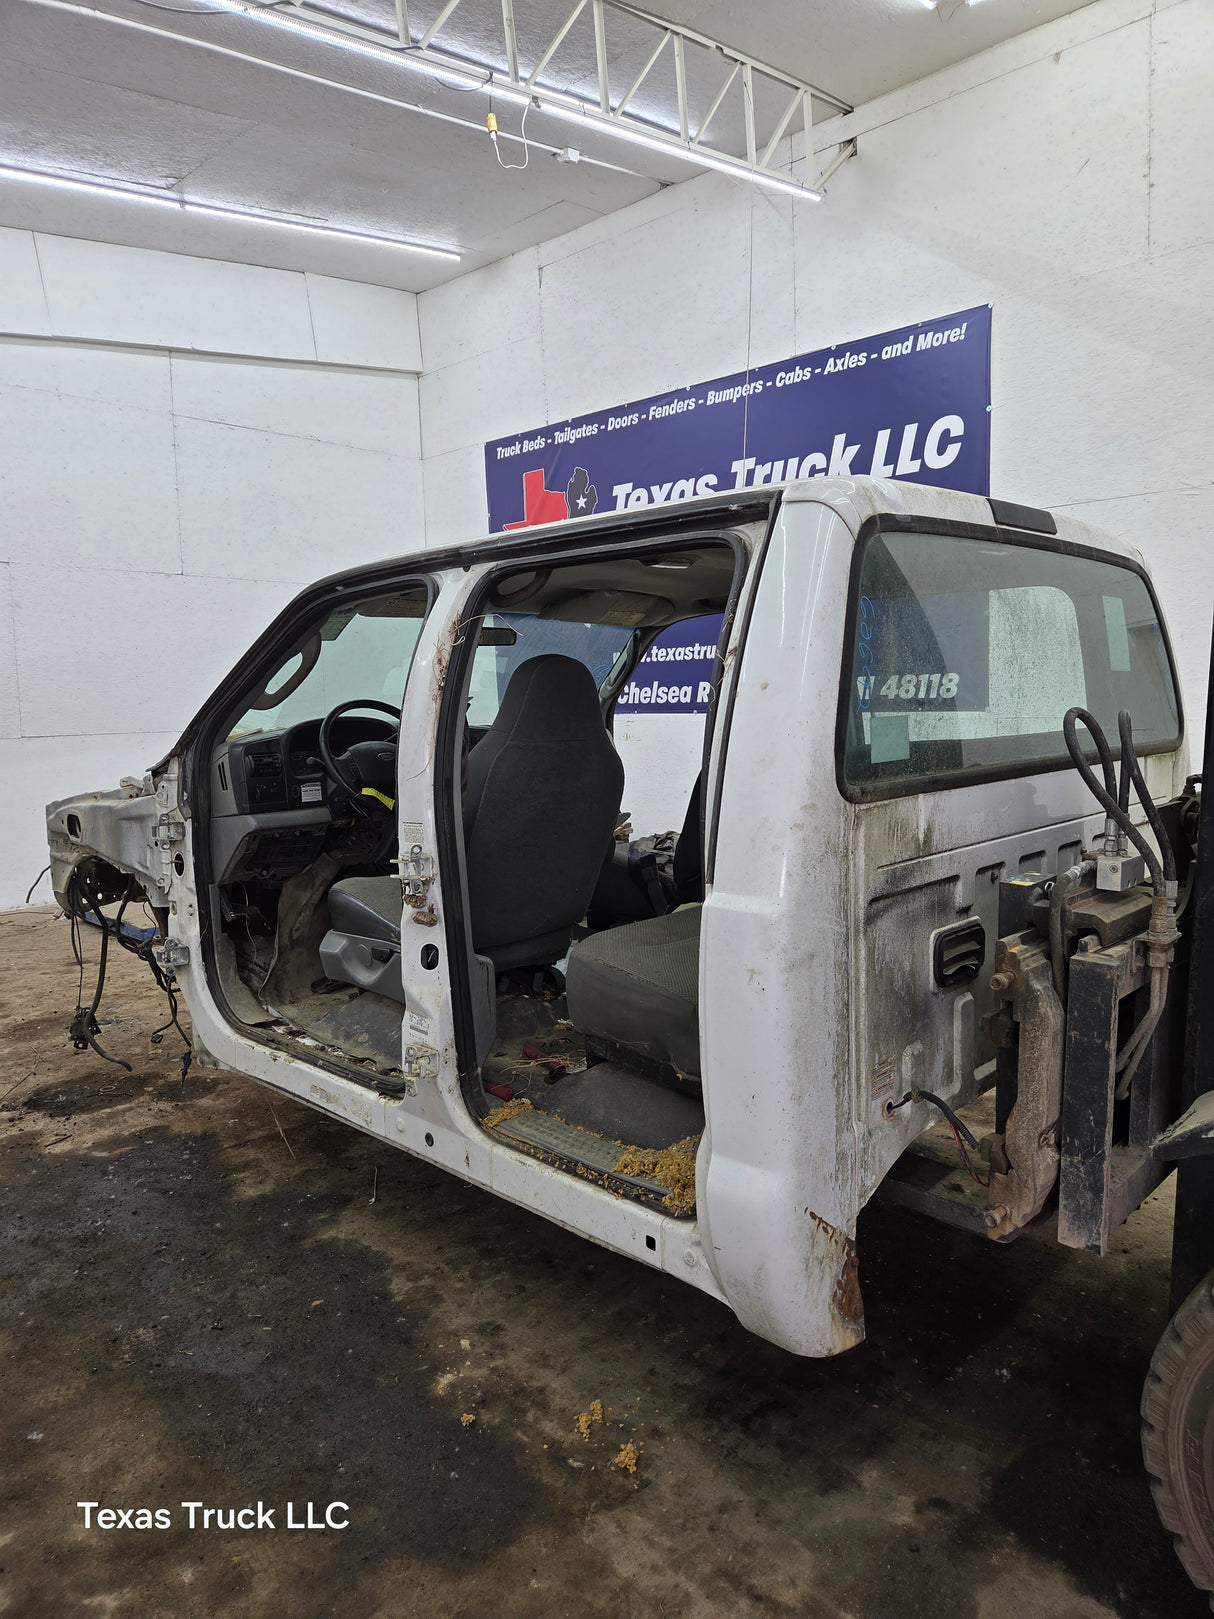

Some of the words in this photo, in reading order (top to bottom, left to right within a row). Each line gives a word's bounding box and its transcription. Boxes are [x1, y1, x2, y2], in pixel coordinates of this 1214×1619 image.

[496, 441, 522, 460] Truck
[522, 435, 546, 453] Beds
[554, 423, 599, 445] Tailgates
[607, 413, 640, 431] Doors
[649, 396, 696, 421] Fenders
[706, 379, 764, 406] Bumpers
[775, 366, 812, 388] Cabs
[824, 351, 868, 376] Axles
[881, 335, 914, 360] and
[916, 322, 968, 352] More!
[612, 474, 718, 511] Texas
[731, 433, 861, 489] Truck
[870, 414, 964, 478] LLC
[617, 681, 692, 704] Chelsea
[697, 681, 711, 703] R
[880, 672, 960, 699] 48118
